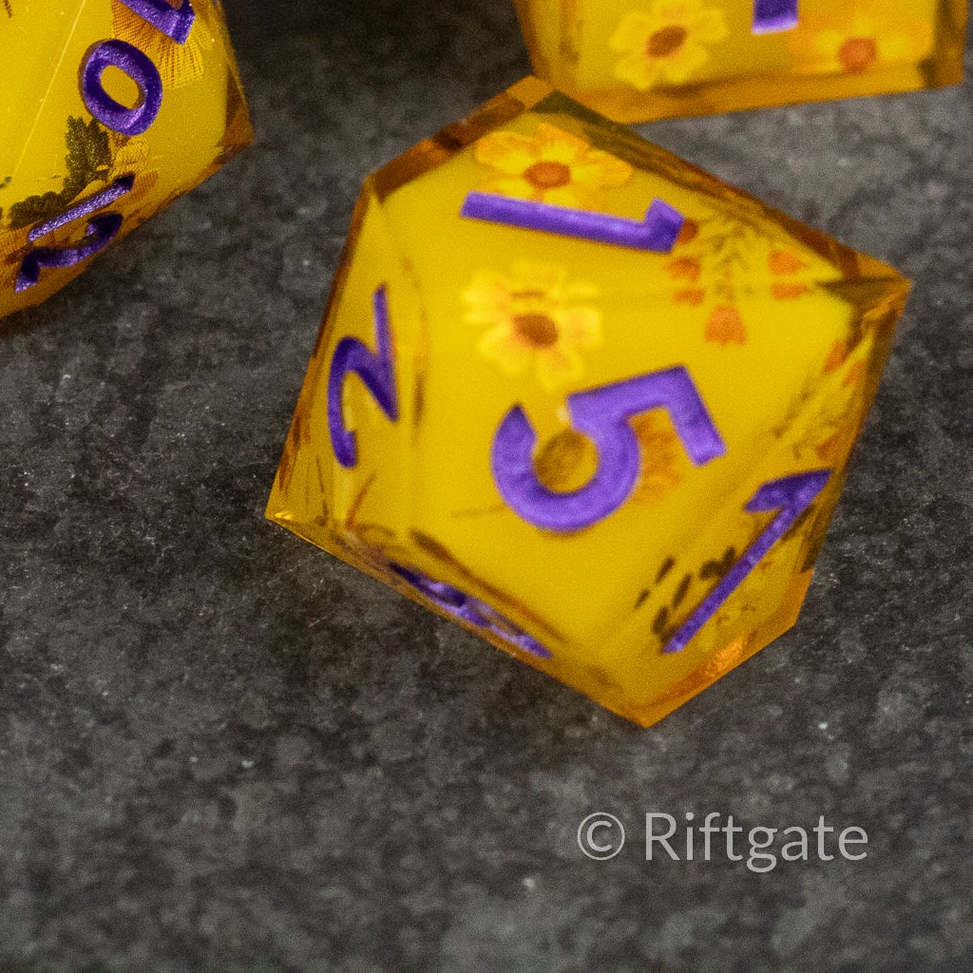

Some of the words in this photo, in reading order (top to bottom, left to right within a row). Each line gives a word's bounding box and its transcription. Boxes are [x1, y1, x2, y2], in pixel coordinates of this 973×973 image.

[13, 172, 136, 294] 12
[459, 190, 686, 254] 1
[327, 282, 399, 469] 2
[490, 364, 727, 532] 5
